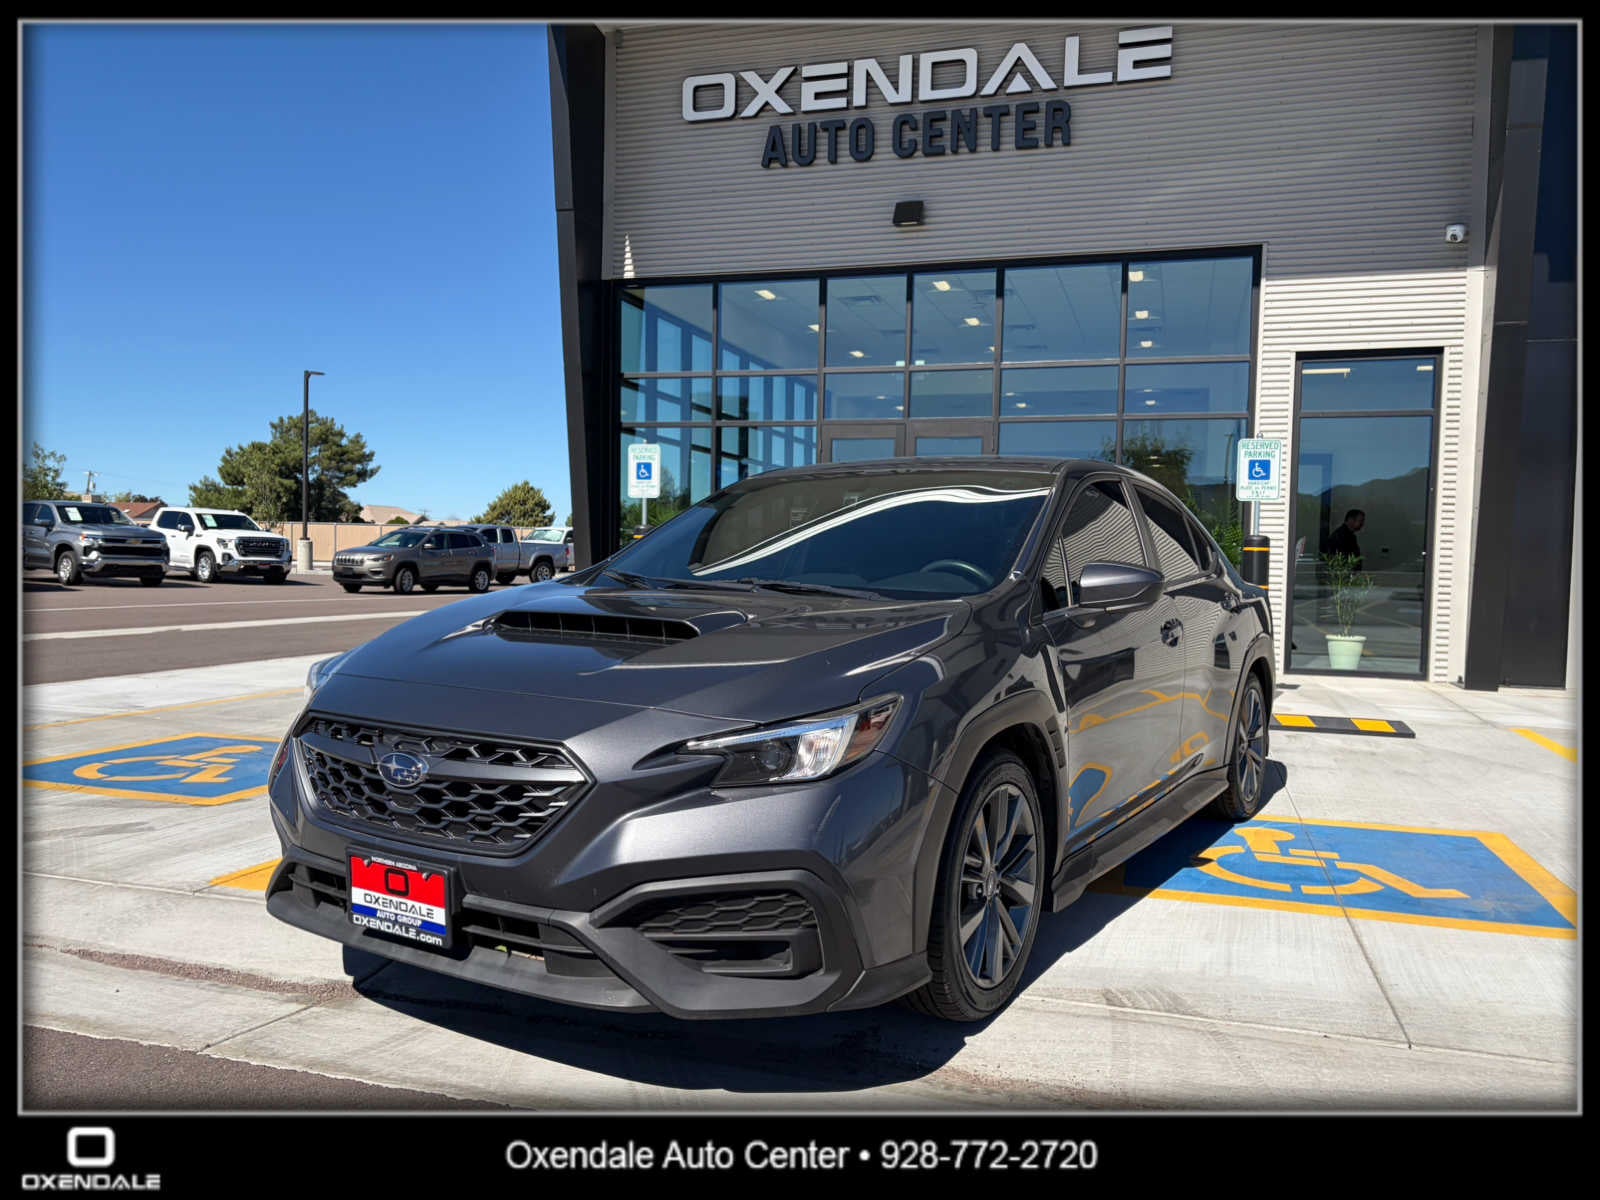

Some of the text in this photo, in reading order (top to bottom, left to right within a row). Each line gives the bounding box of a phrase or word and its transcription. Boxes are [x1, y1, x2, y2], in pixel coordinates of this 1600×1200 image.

[682, 26, 1174, 122] OXENDALE
[761, 100, 1071, 169] AUTO CENTER
[1241, 440, 1280, 450] RESERVED
[1244, 450, 1276, 459] PARKING
[363, 893, 435, 919] OXENDALE
[376, 909, 423, 927] AUTO GROUP
[353, 914, 443, 946] OXENDALE.com
